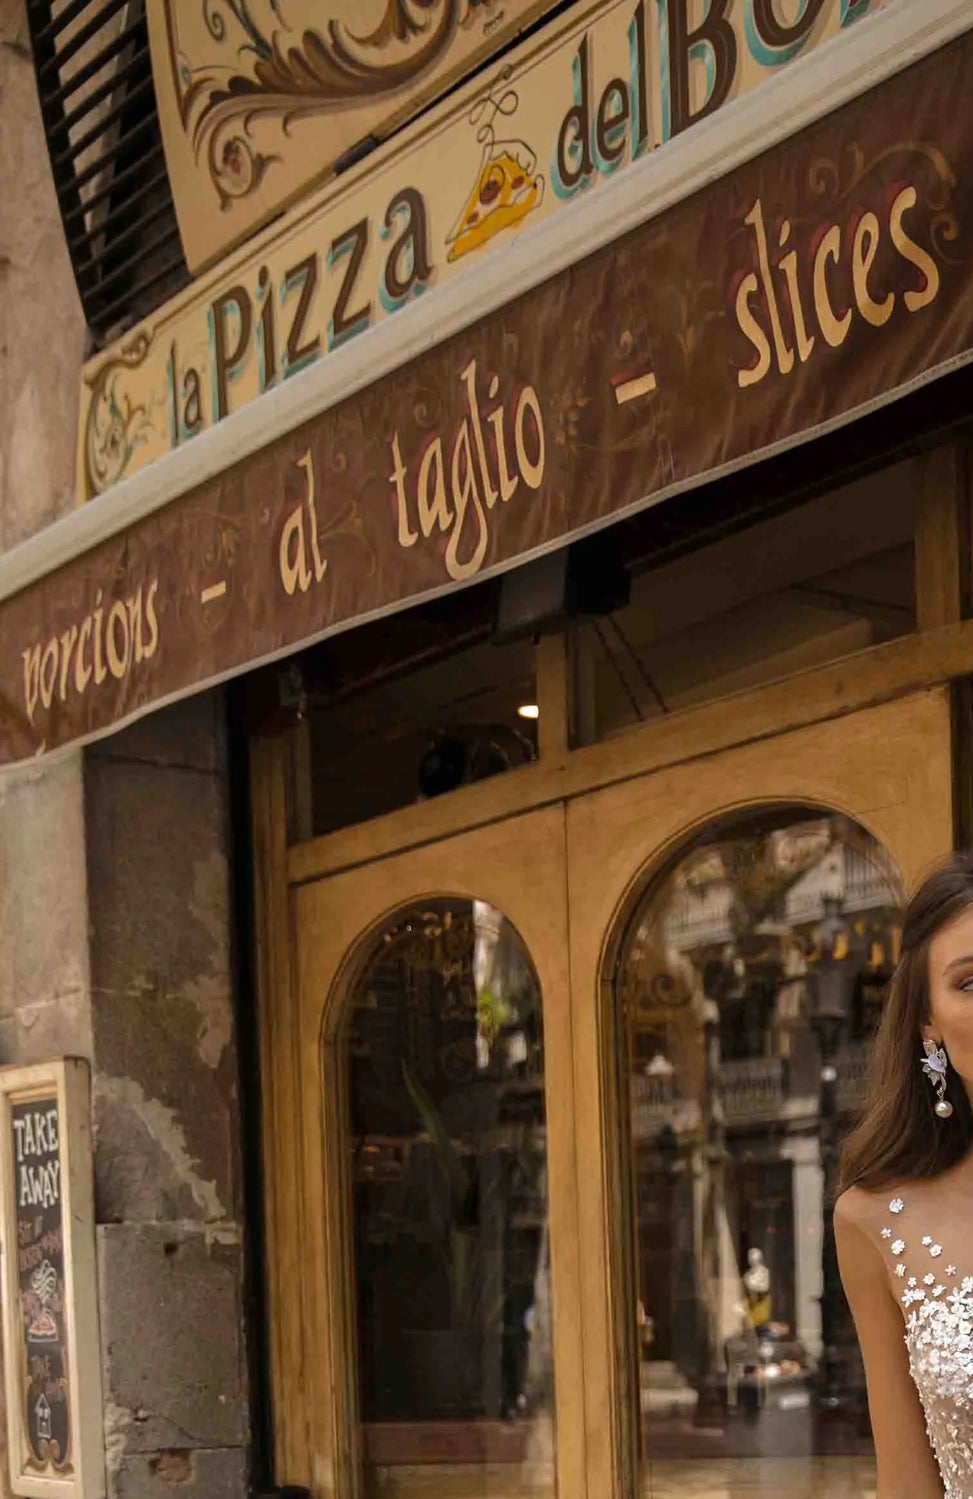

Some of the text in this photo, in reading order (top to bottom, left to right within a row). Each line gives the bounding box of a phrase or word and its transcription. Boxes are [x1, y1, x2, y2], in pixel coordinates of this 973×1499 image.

[168, 339, 204, 448] la
[278, 449, 328, 596] al
[389, 359, 546, 580] taglio
[737, 185, 941, 389] slices
[13, 1109, 60, 1162] TAKE
[18, 1159, 61, 1209] AWAY
